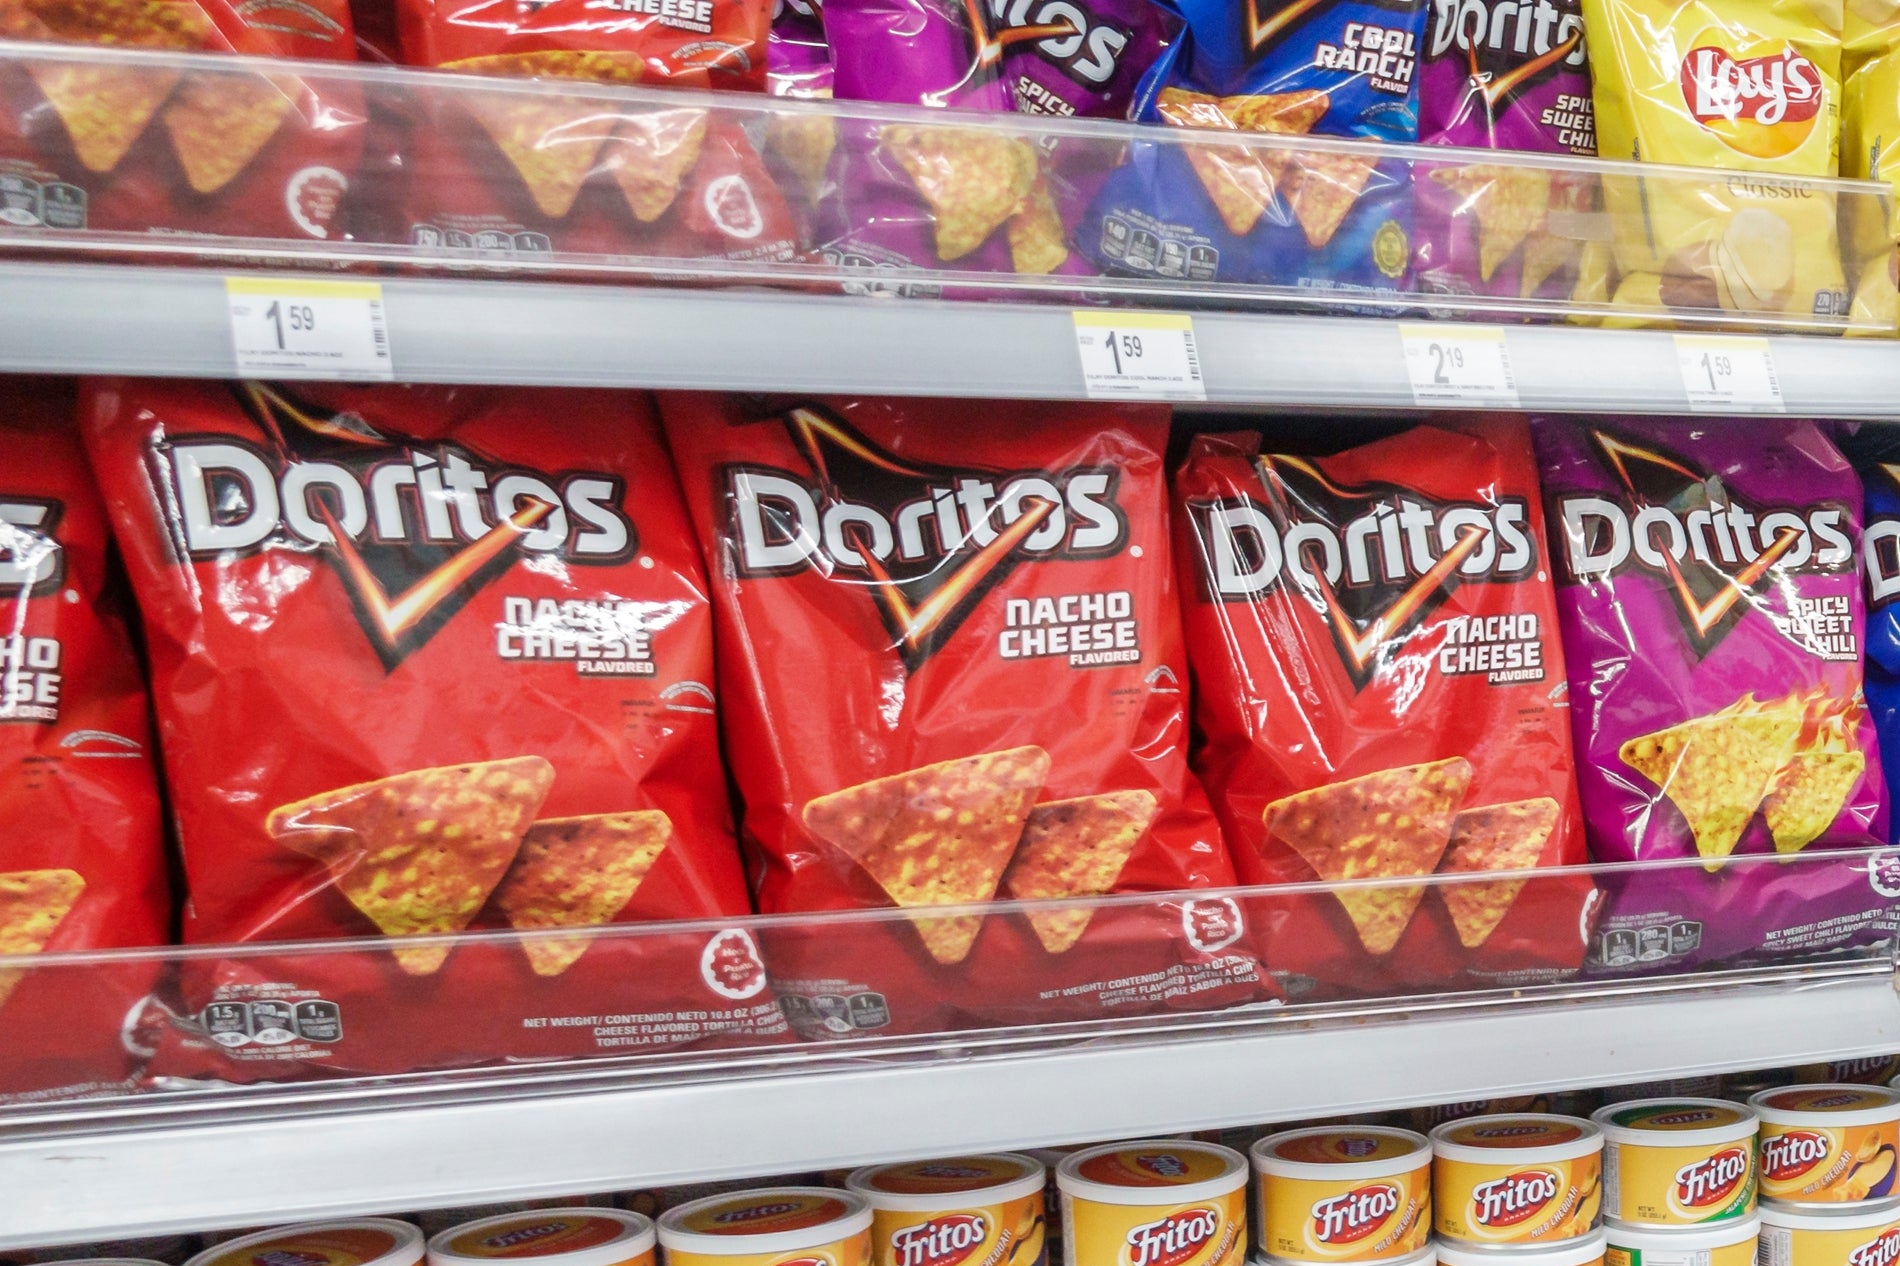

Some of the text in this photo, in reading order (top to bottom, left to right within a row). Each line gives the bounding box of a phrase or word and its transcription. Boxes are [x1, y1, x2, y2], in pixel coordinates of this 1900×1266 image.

[1344, 22, 1416, 57] COOL
[1314, 44, 1415, 81] RANCH
[170, 443, 632, 554] Doritos
[735, 468, 1120, 570] Doritos
[1561, 498, 1853, 574] Doritos
[1208, 498, 1529, 597] Doritos
[1005, 593, 1131, 627] NACHO
[1788, 597, 1849, 615] SPICY
[1001, 622, 1137, 658] CHEESE
[1447, 614, 1537, 644] NACHO
[578, 661, 653, 674] FLAVORED
[1070, 650, 1140, 664] FLAVORED
[1440, 642, 1540, 673] CHEESE
[1489, 669, 1543, 682] FLAVORED
[524, 1018, 548, 1027] NET
[606, 1012, 673, 1025] CONTENIDO
[676, 1011, 707, 1021] NETO
[1312, 1186, 1397, 1241] Fritos
[1473, 1172, 1556, 1222] Fritos
